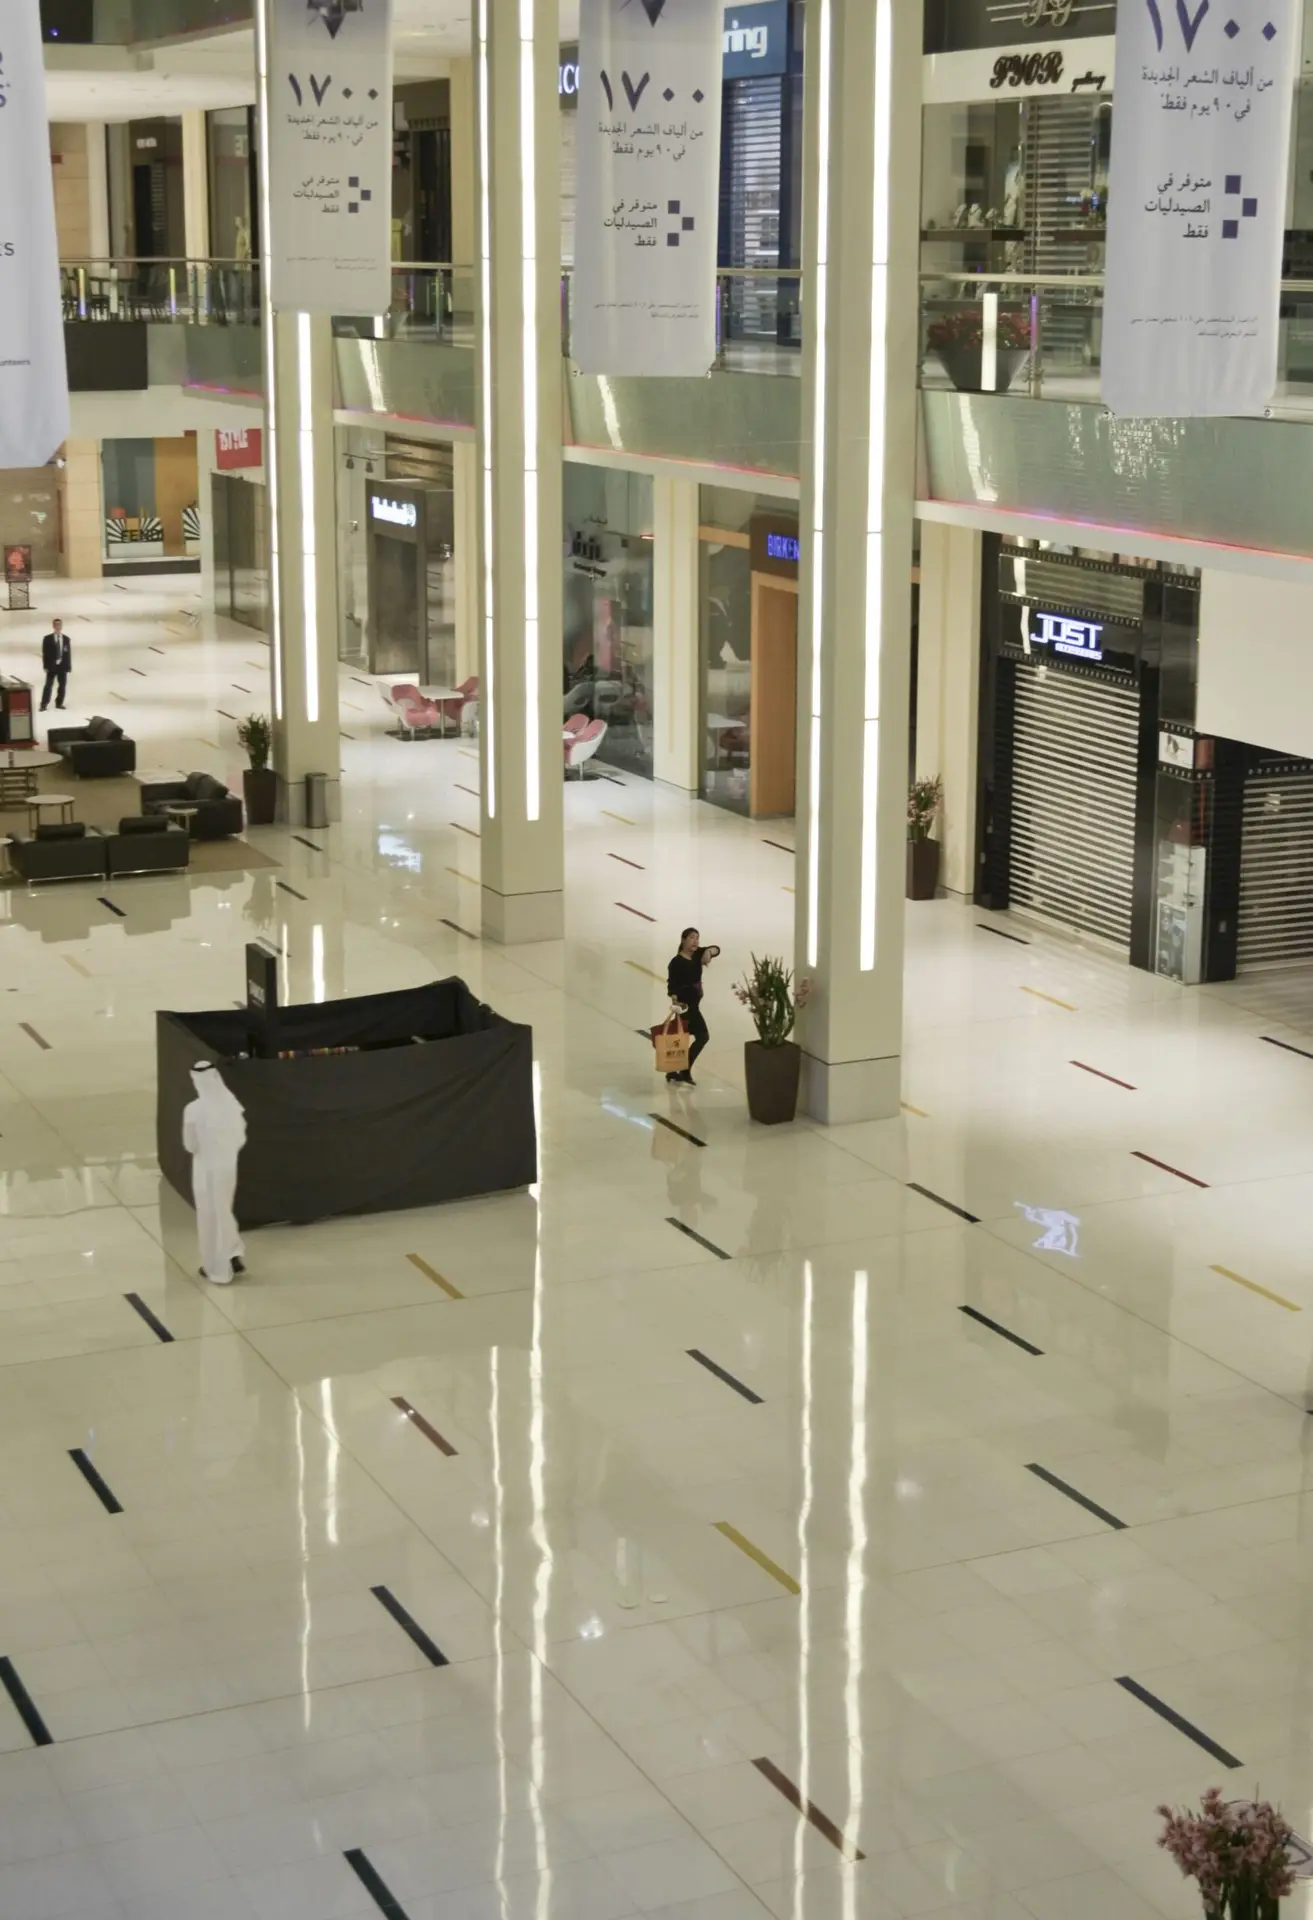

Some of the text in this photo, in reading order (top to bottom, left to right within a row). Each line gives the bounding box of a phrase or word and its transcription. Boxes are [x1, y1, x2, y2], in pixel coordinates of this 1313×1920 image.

[1141, 66, 1180, 87] الجديدة
[1183, 68, 1219, 88] الشعر
[1256, 79, 1273, 92] من
[289, 72, 378, 107] ١٧٠٠
[600, 69, 704, 112] ١٧٠٠
[1190, 104, 1210, 119] يوم
[1234, 98, 1251, 122] في
[690, 130, 703, 141] من
[1157, 173, 1212, 195] متوفر في
[612, 199, 658, 216] متوفر في
[1144, 198, 1211, 216] الصيدليات
[603, 217, 658, 231] الصيدليات
[1182, 222, 1209, 239] فقط
[634, 235, 657, 247] فقط
[1030, 612, 1104, 650] JUST
